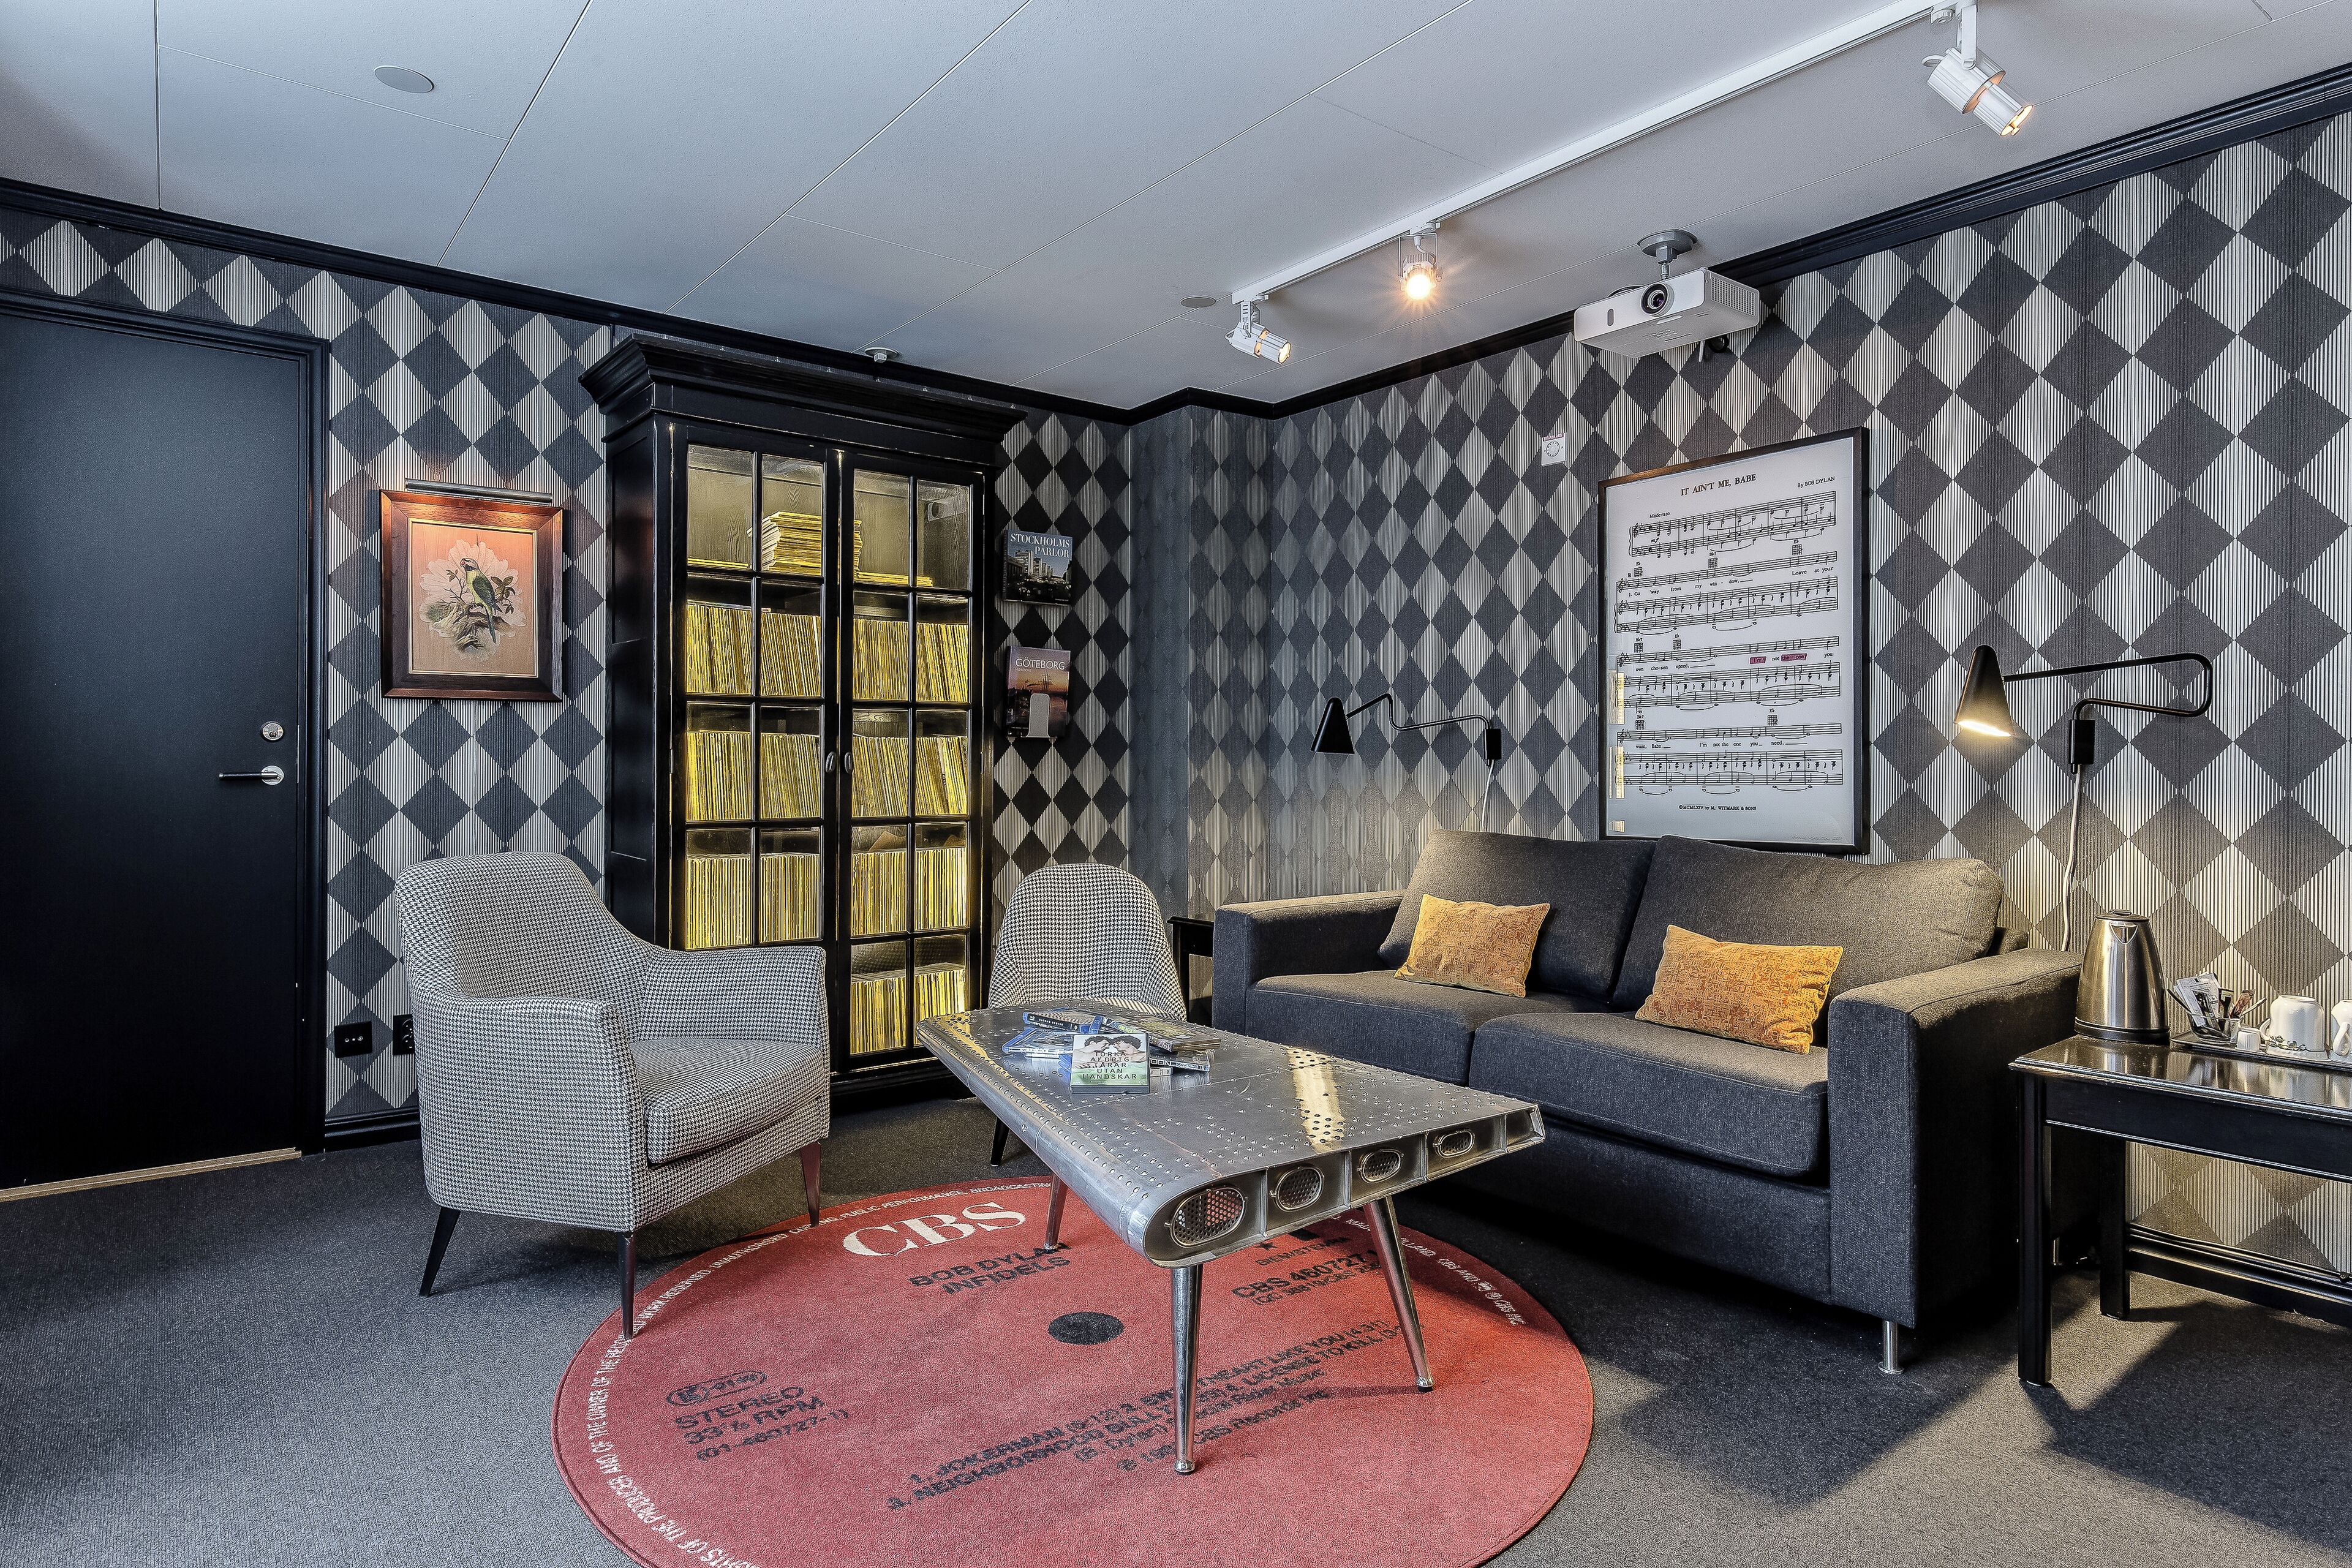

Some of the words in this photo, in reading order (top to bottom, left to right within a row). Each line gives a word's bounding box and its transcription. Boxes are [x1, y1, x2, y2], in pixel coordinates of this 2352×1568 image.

[1692, 482, 1714, 494] AIN'T
[1718, 479, 1732, 488] ME,
[1735, 473, 1757, 485] BABE
[1815, 476, 1835, 484] DYLAN
[1010, 533, 1070, 548] STOCKHOLMS
[1035, 545, 1069, 559] PÄRLOR
[1016, 657, 1065, 670] GÖTEBORG
[883, 1189, 968, 1208] PERFORMANCE,
[839, 1205, 881, 1220] PUBLIC
[842, 1202, 1026, 1257] CBS
[908, 1265, 974, 1287] BOB
[942, 1256, 1071, 1294] INFIDELS
[1233, 1275, 1291, 1298] CBS
[1292, 1253, 1370, 1281] 460727
[637, 1298, 669, 1319] WORK
[596, 1360, 619, 1374] THE
[592, 1377, 610, 1386] OF
[1277, 1370, 1324, 1387] Music
[588, 1390, 608, 1420] OWNER
[676, 1387, 804, 1429] STEREO
[753, 1397, 823, 1424] RPM
[910, 1474, 932, 1483] 1.
[937, 1428, 1063, 1475] JOKERMAN
[1120, 1403, 1142, 1414] 2.
[1268, 1346, 1308, 1363] LIKE
[1311, 1335, 1344, 1347] YOU
[1230, 1399, 1302, 1429] Records
[914, 1431, 1103, 1499] NEIGHBORHOOD
[1105, 1404, 1174, 1434] BULLY
[1243, 1356, 1320, 1385] LICENSE
[1316, 1348, 1344, 1358] TO
[1342, 1337, 1381, 1350] KILL
[587, 1422, 606, 1439] THE
[592, 1441, 613, 1452] OF
[595, 1454, 622, 1475] AND
[606, 1475, 665, 1524] PRODUCER
[650, 1520, 688, 1542] THE
[677, 1539, 707, 1553] OF
